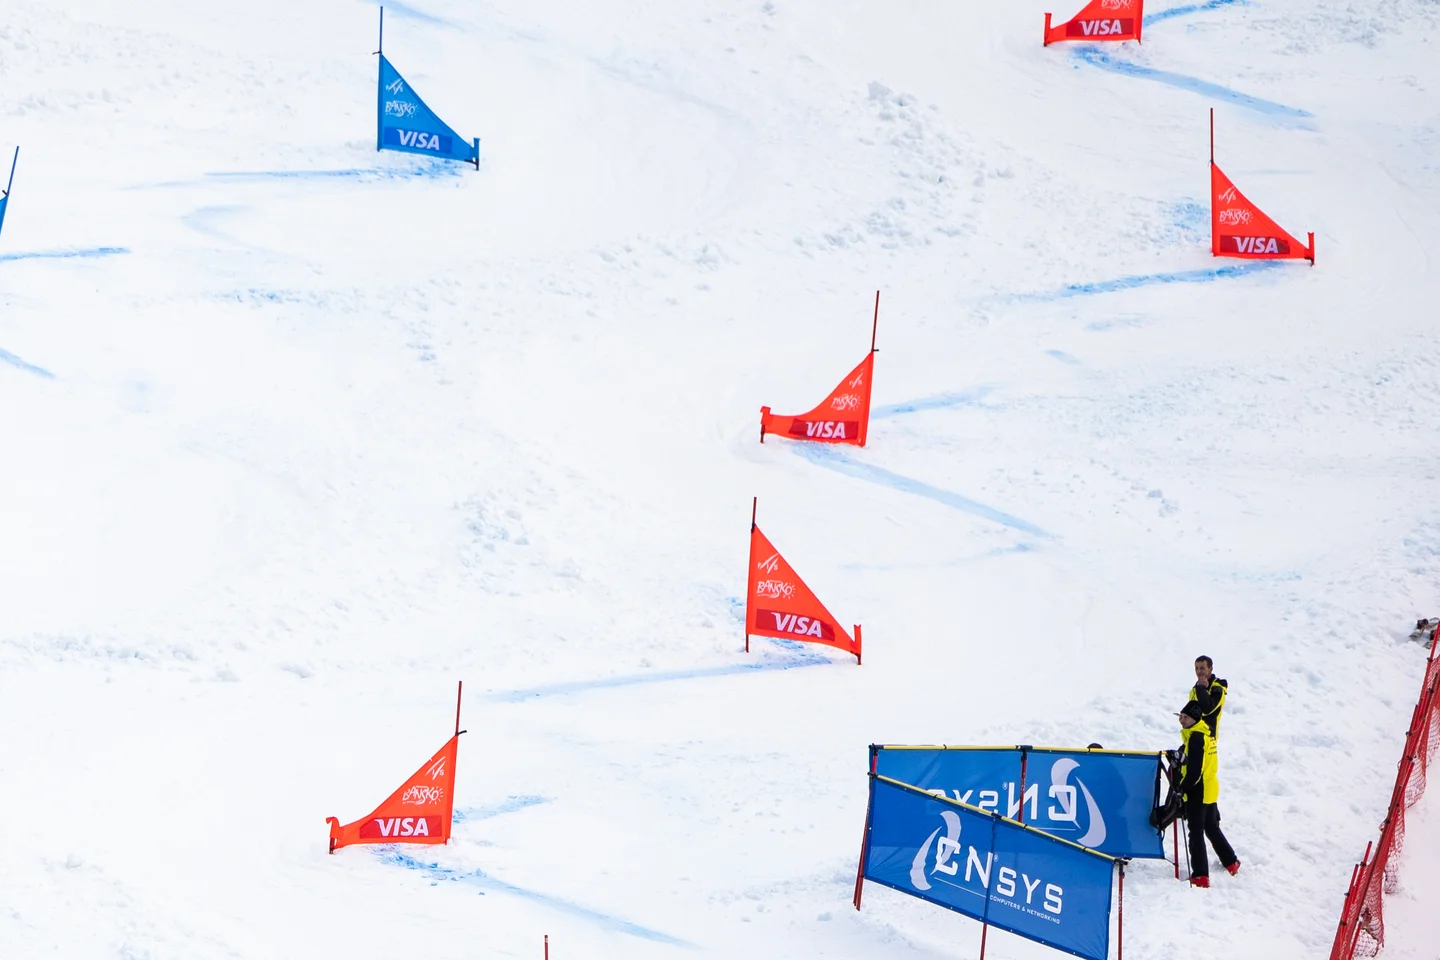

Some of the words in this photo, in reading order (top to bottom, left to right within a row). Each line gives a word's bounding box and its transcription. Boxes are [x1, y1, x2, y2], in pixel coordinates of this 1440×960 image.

[1078, 20, 1122, 36] VISA
[397, 130, 440, 151] VISA
[1232, 236, 1278, 254] VISA
[806, 421, 846, 439] VISA
[771, 612, 822, 638] VISA
[374, 816, 429, 838] VISA
[990, 894, 1020, 910] COMPUTERS
[1027, 908, 1060, 924] NETWORKING
